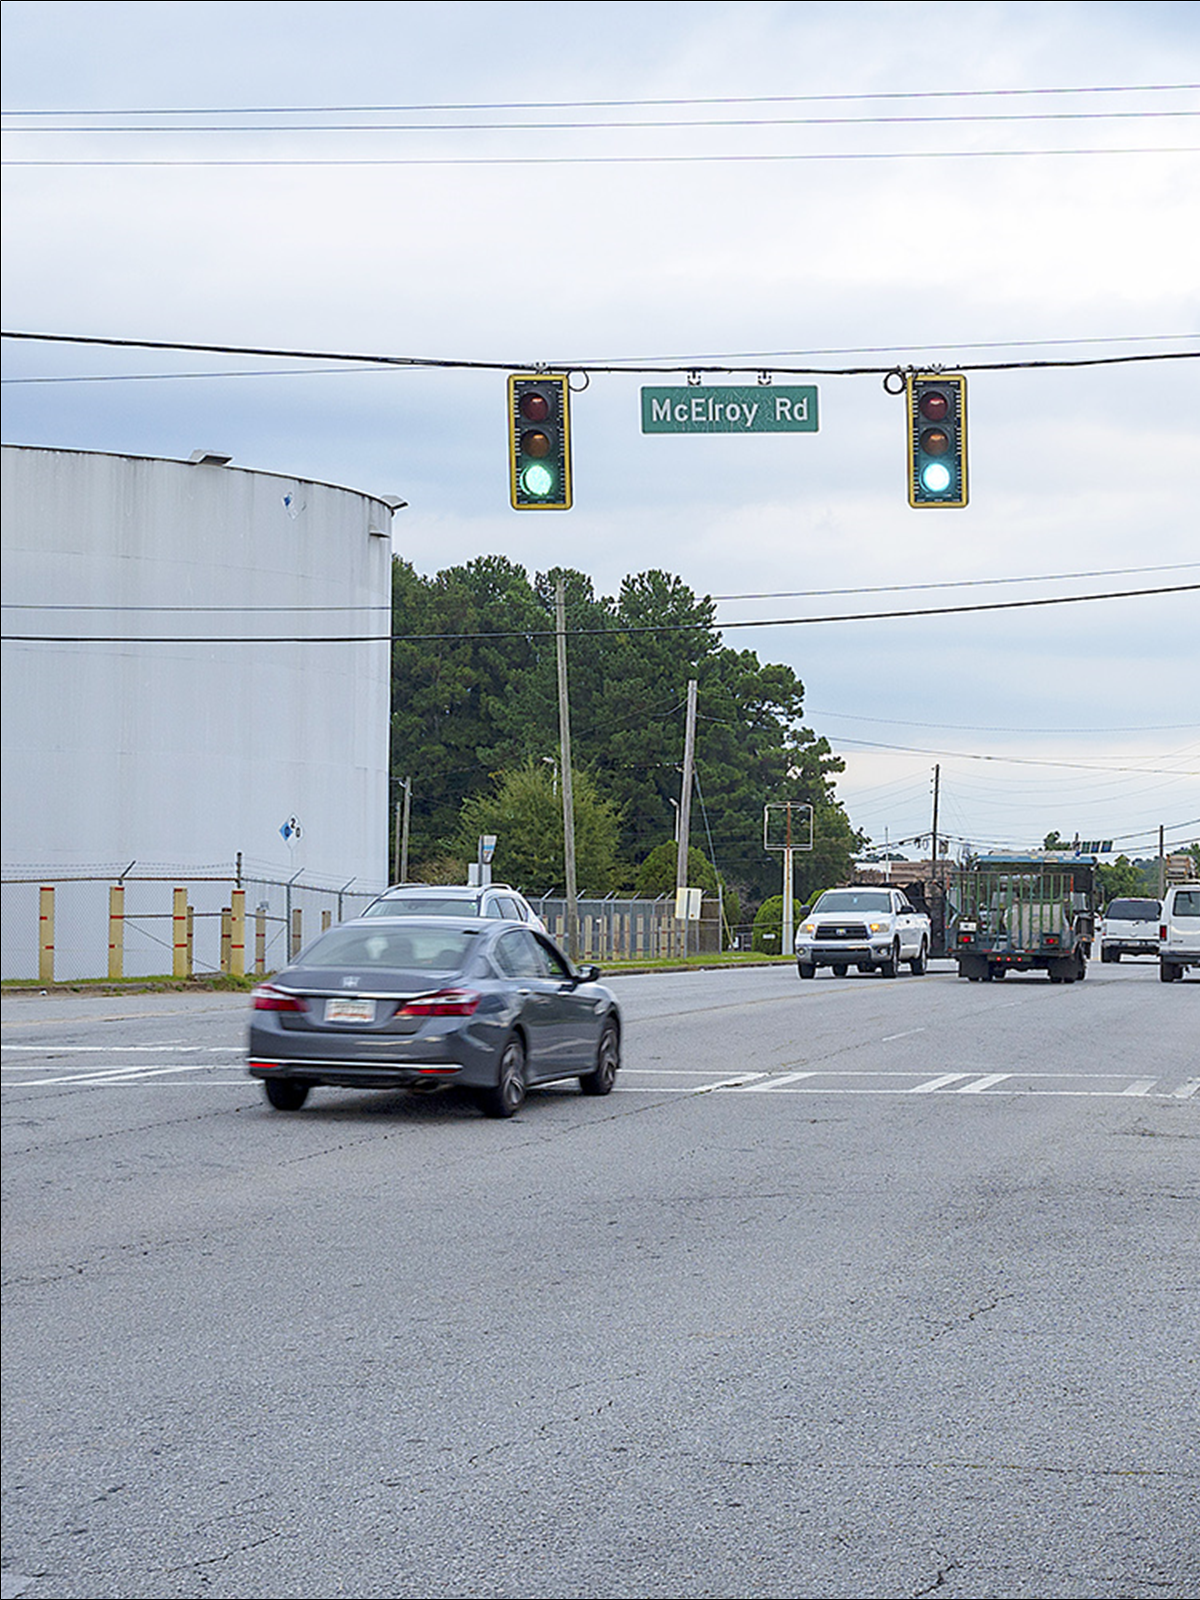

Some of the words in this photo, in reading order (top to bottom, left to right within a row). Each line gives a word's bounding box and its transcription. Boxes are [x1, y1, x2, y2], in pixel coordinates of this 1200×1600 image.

[652, 397, 758, 427] McElroy
[775, 397, 808, 421] Rd
[290, 817, 296, 829] 2
